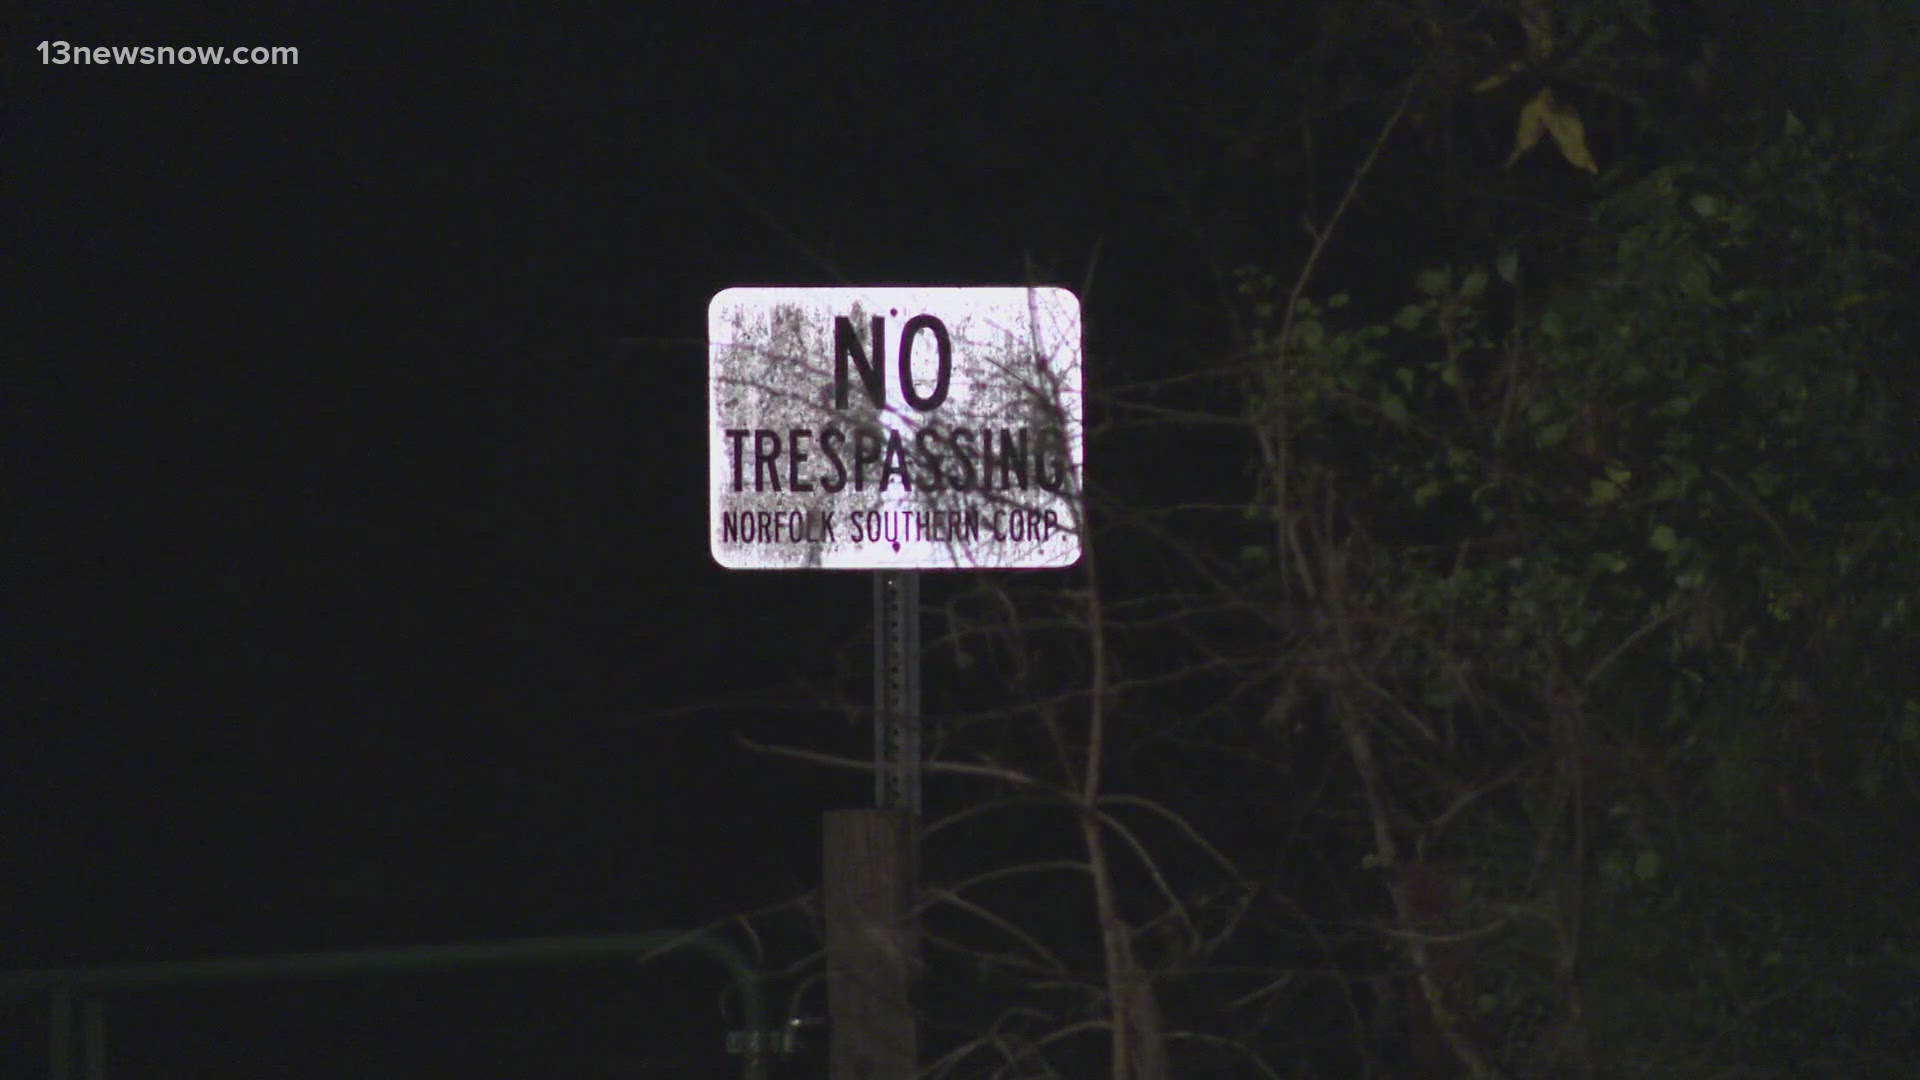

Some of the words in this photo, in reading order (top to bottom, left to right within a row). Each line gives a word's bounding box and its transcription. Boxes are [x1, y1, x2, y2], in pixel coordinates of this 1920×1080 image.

[834, 313, 952, 412] NO
[725, 428, 1066, 493] TRESPASSING
[723, 511, 835, 543] NORFOLK
[850, 511, 979, 543] SOUTHERN
